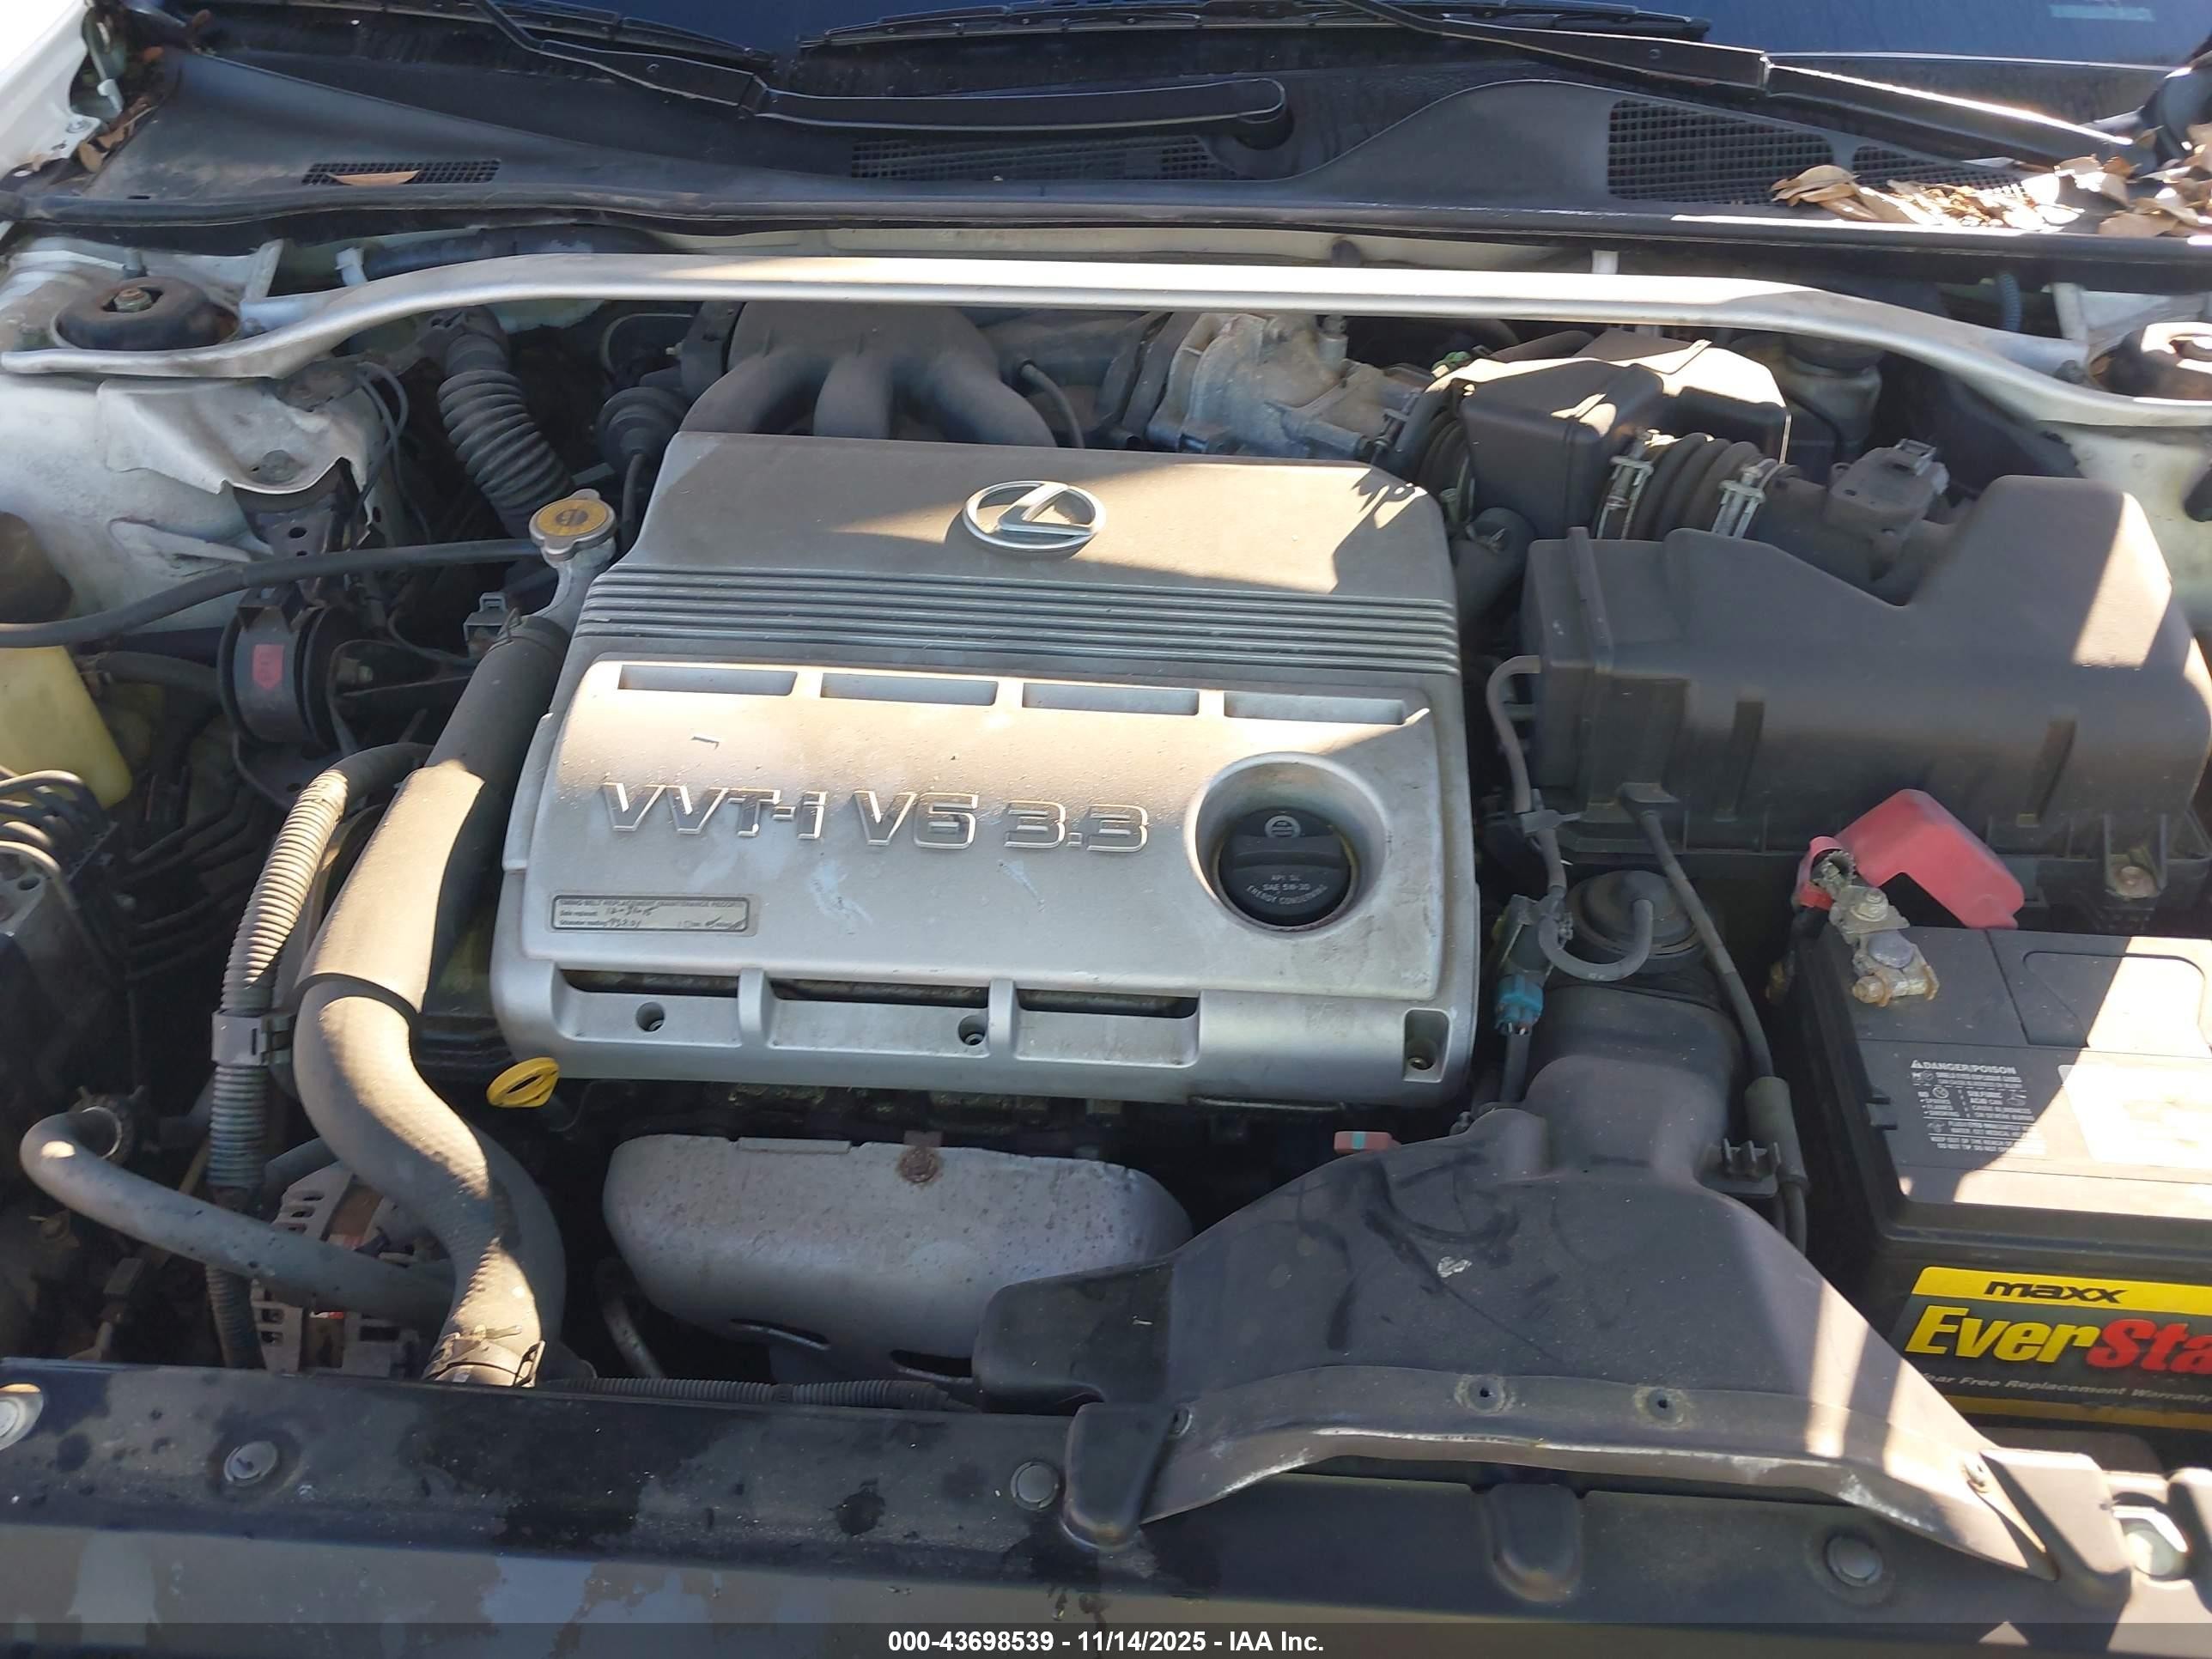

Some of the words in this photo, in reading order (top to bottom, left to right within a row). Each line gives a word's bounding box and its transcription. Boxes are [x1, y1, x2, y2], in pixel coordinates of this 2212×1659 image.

[854, 791, 980, 849] V6
[1003, 799, 1149, 852] 3.3
[1262, 883, 1280, 891] SAE
[1984, 1280, 2128, 1304] maxx
[1959, 1376, 2001, 1388] Free
[2004, 1380, 2127, 1395] Replacement
